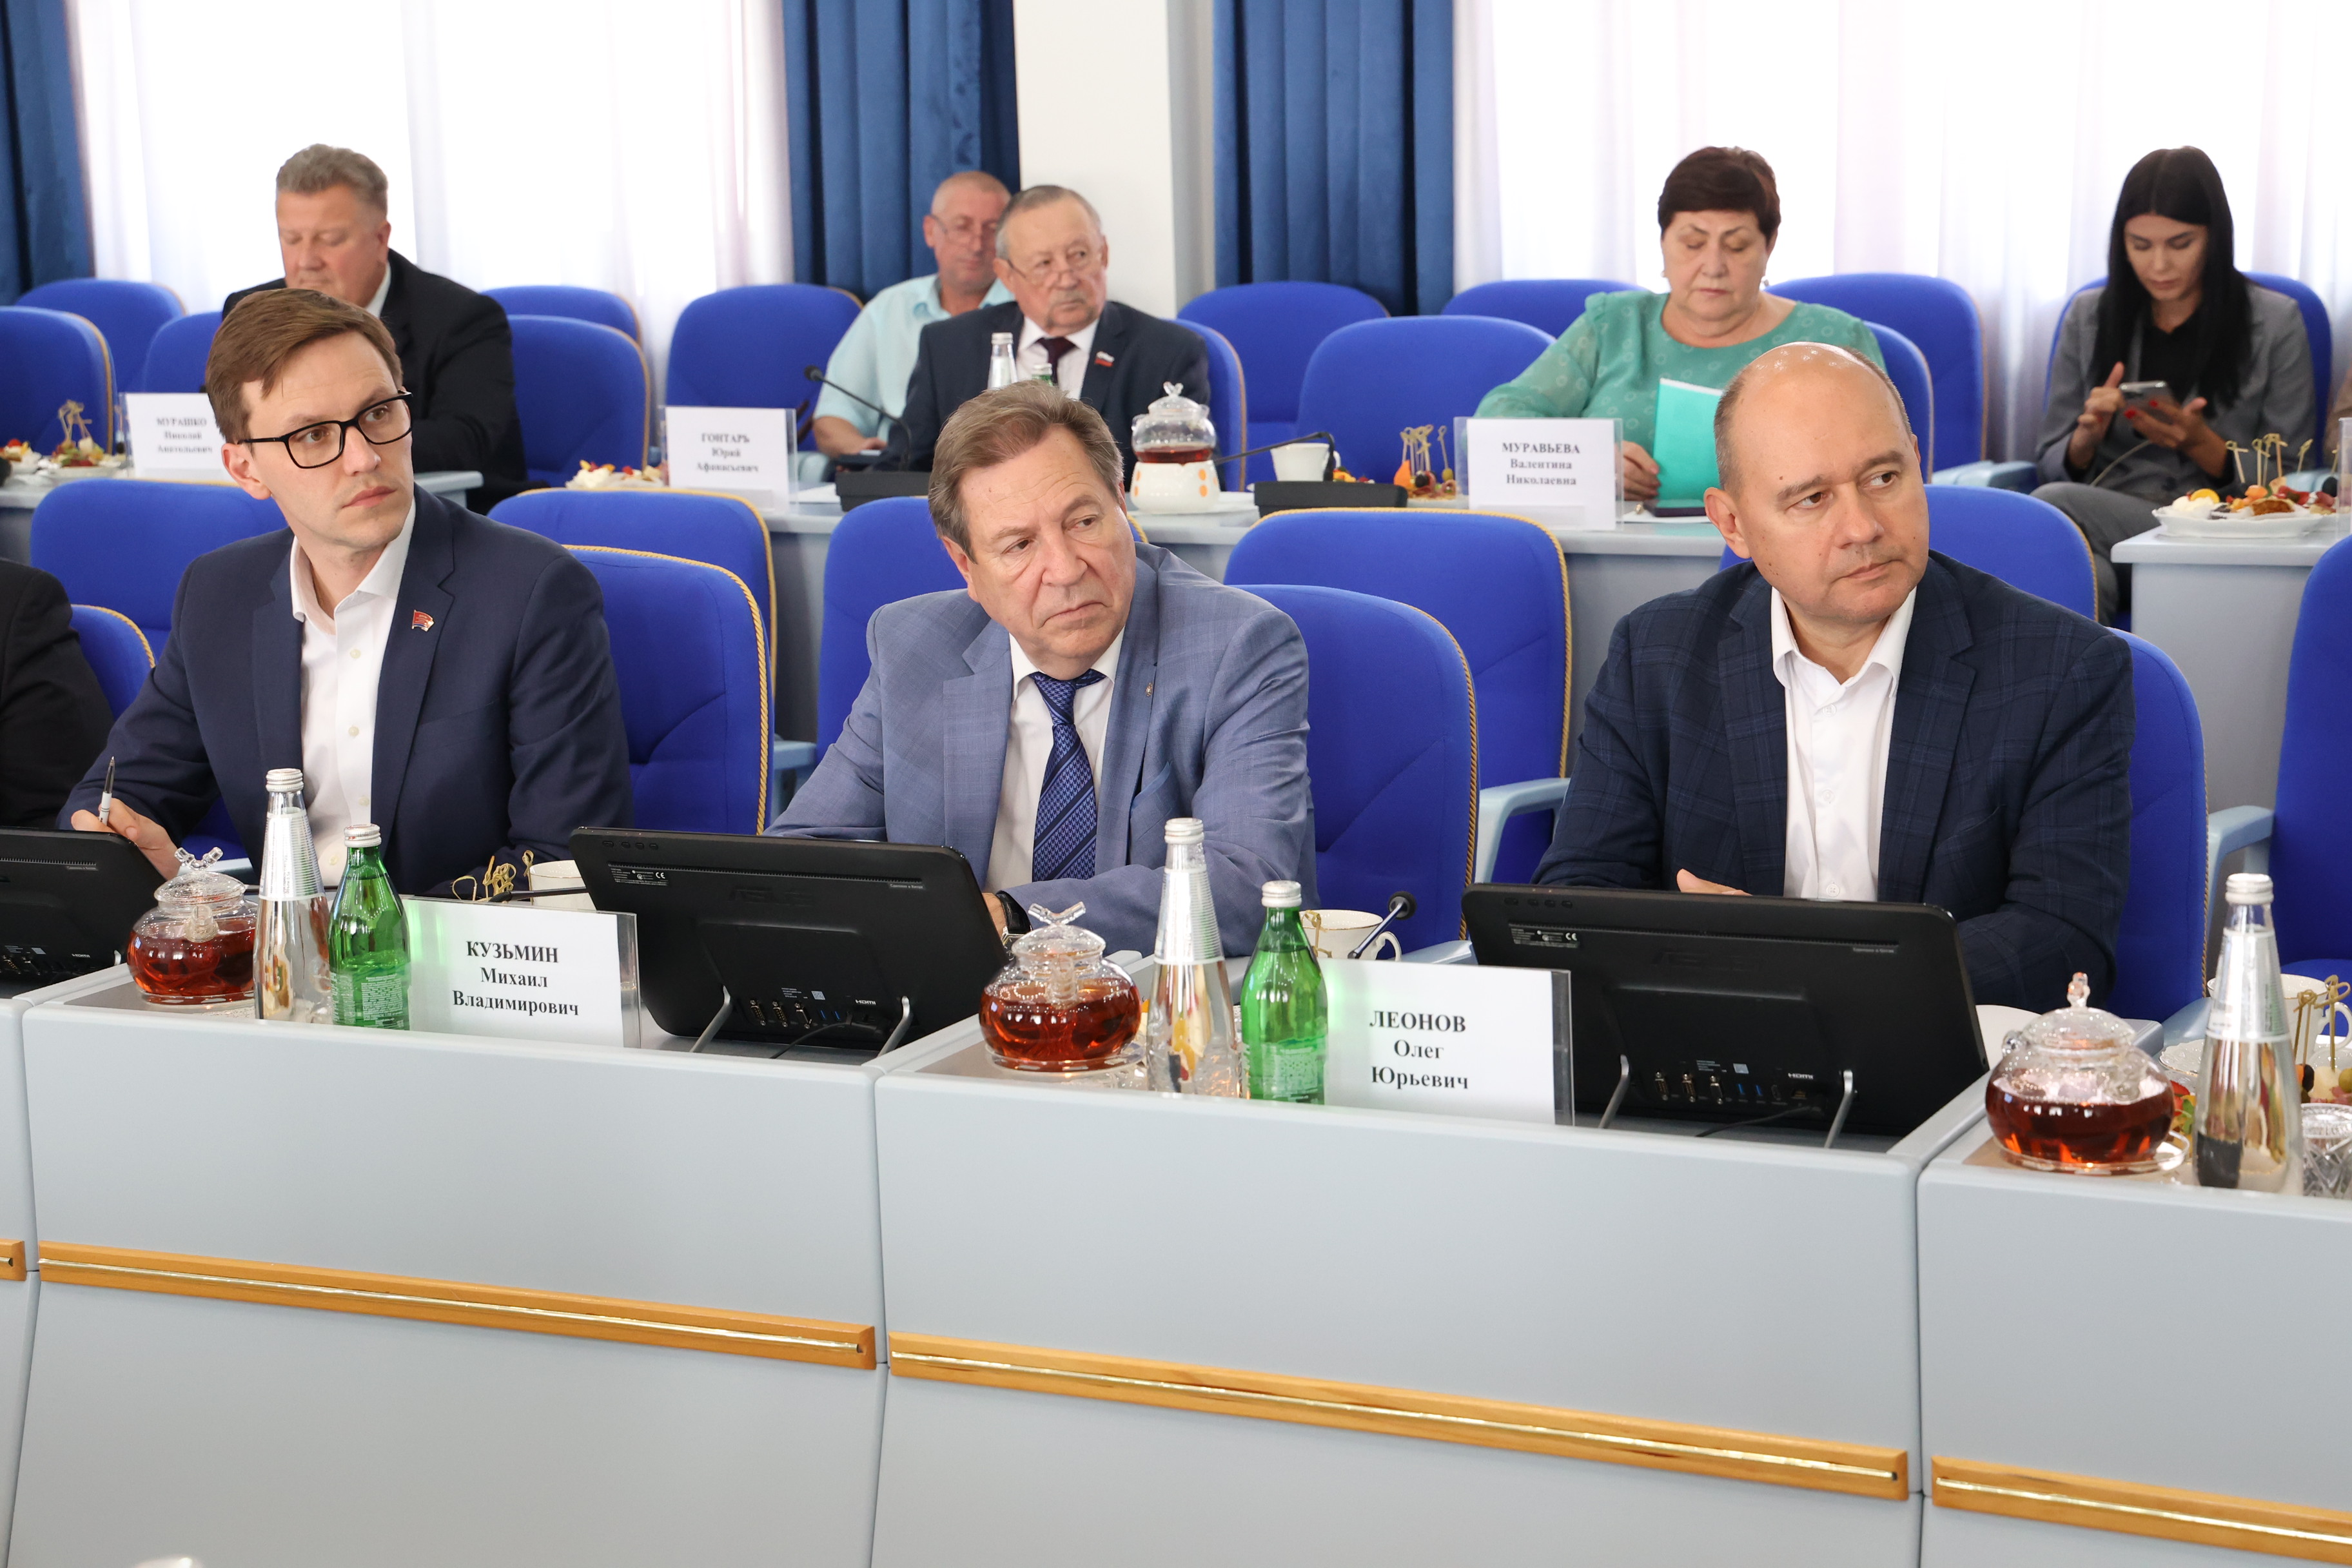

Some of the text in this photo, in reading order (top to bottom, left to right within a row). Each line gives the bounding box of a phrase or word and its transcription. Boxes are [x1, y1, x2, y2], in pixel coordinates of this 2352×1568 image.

[157, 418, 207, 426] МУРАШКО
[701, 433, 750, 443] ГОНТАРЬ
[712, 447, 741, 458] Юрий
[1502, 442, 1580, 454] МУРАВЬЕВА
[1511, 458, 1572, 469] Валентина
[1507, 474, 1576, 485] Николаевна
[466, 941, 558, 963] КУЗЬМИН
[480, 967, 548, 988] Михаил
[453, 990, 579, 1017] Владимирович
[1369, 1010, 1466, 1032] ЛЕОНОВ
[1394, 1039, 1444, 1059] Олег
[1371, 1066, 1468, 1090] Юрьевич
